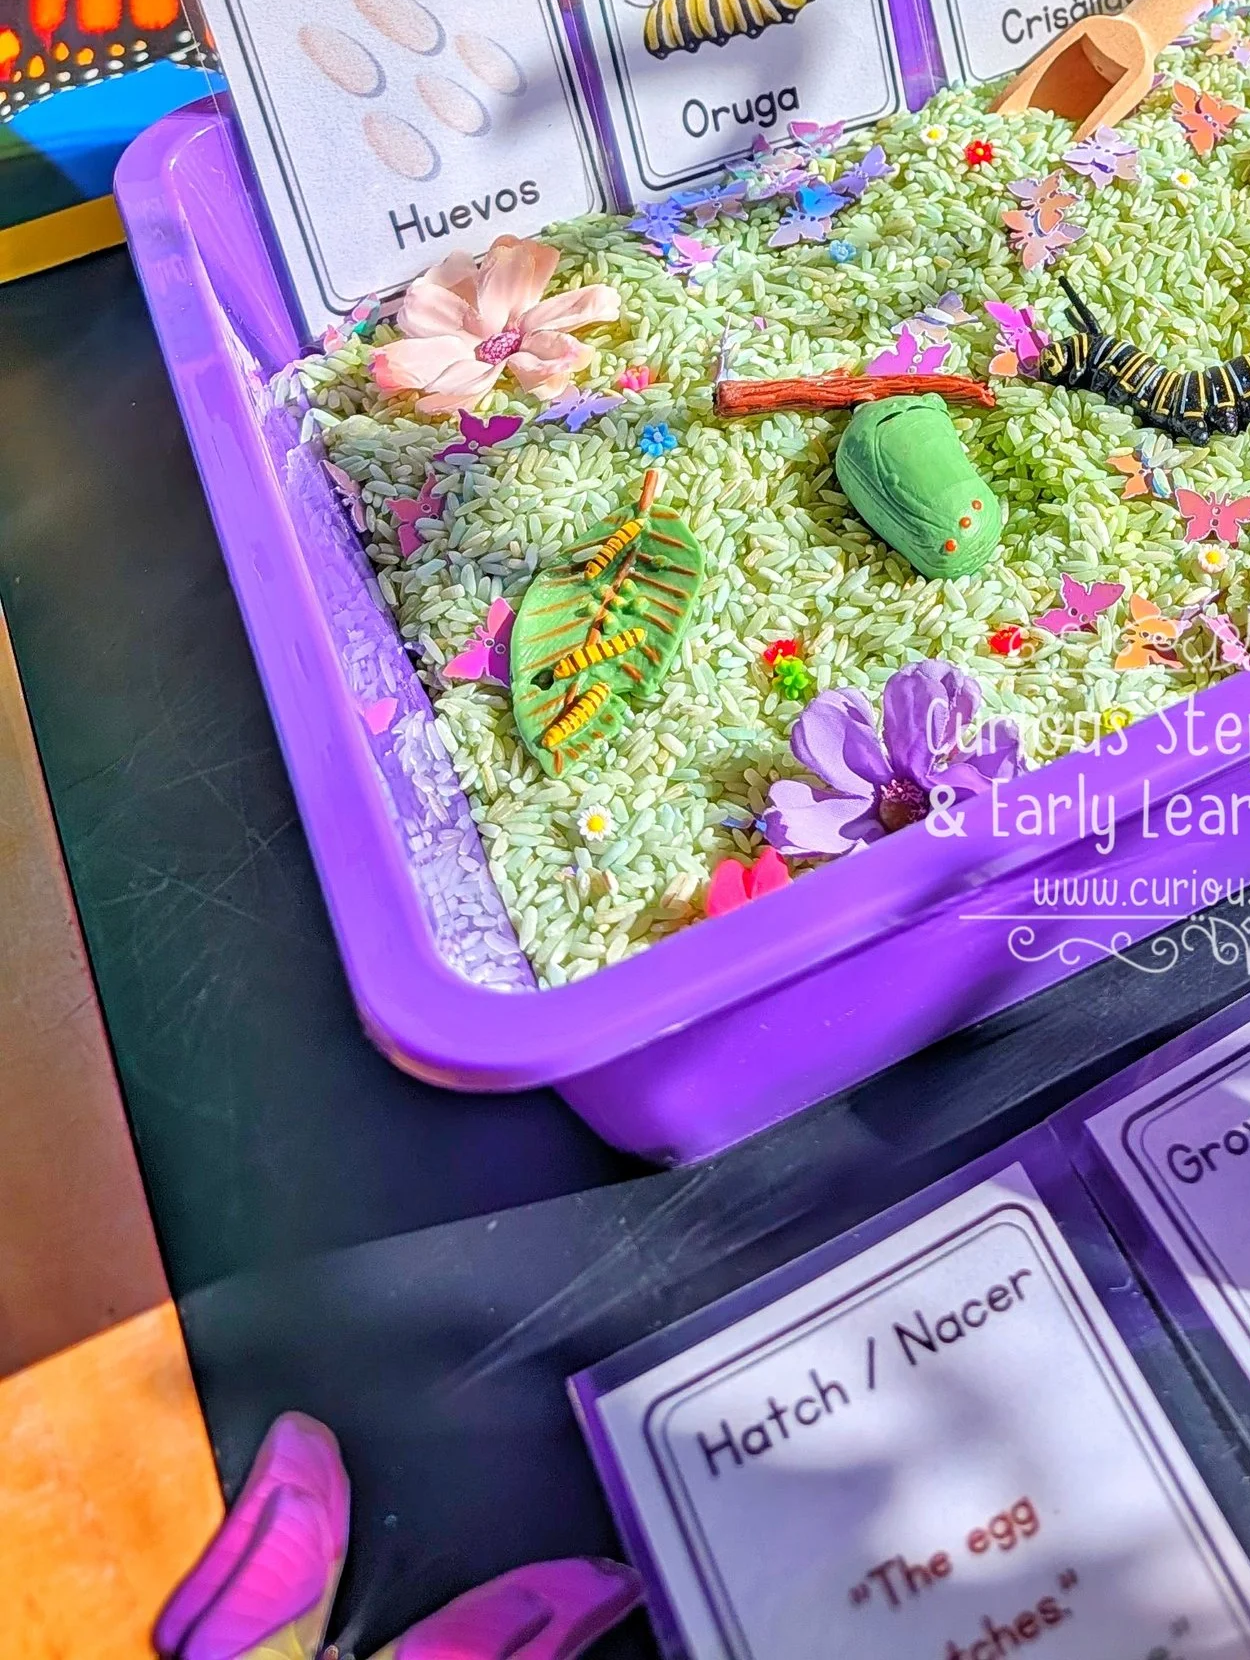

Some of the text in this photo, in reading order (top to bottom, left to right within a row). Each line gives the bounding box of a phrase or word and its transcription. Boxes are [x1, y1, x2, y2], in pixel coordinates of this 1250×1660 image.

[682, 85, 799, 138] Oruga
[389, 178, 540, 249] Huevos
[696, 1269, 1033, 1479] Hatch / Nacer
[966, 1496, 1039, 1555] egg
